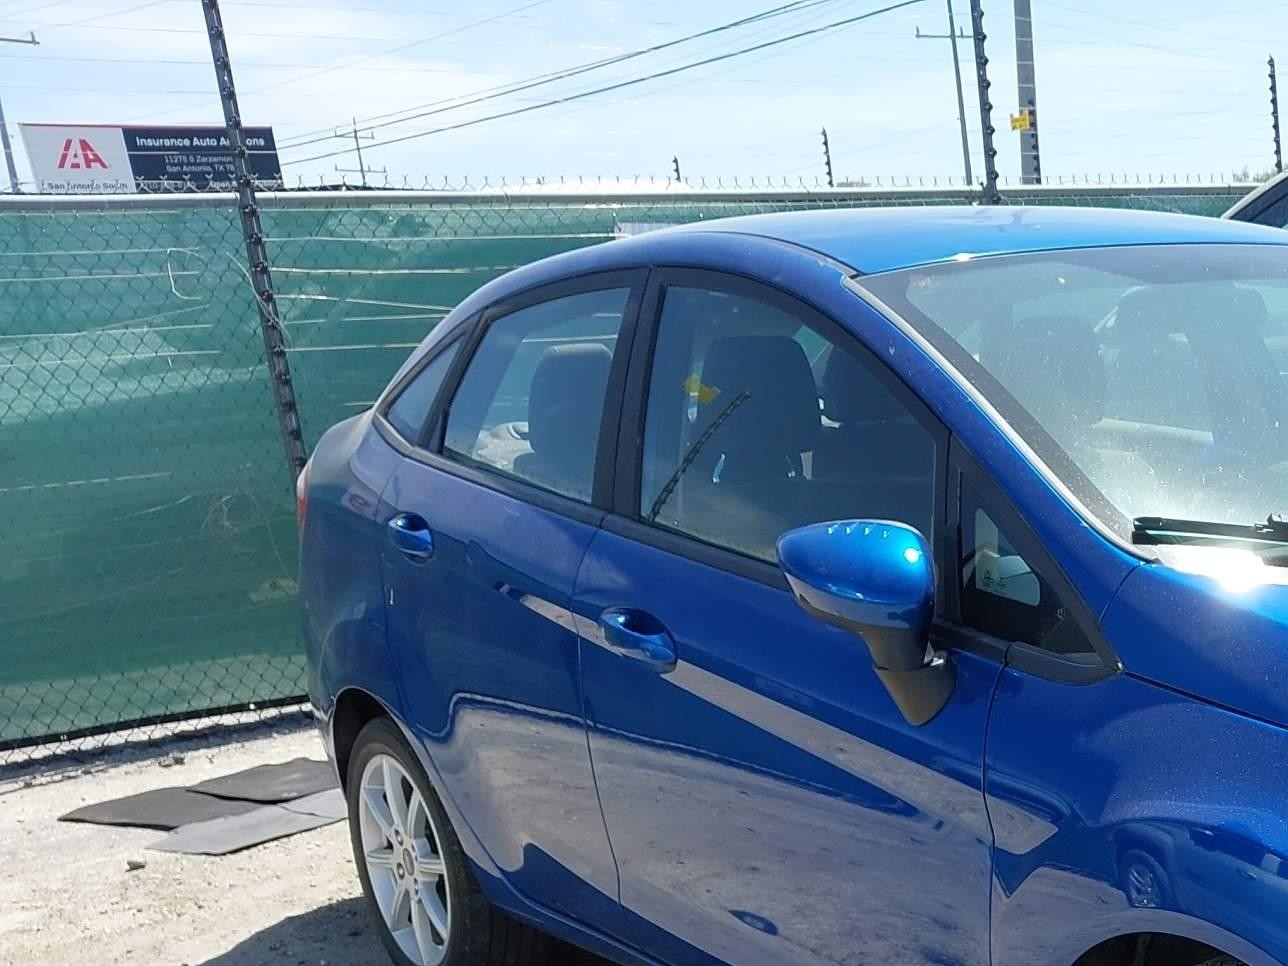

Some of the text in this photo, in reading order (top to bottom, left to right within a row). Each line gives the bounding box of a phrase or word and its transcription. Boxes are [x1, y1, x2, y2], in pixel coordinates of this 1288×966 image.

[136, 136, 265, 147] Insurance Auto Aons
[215, 164, 224, 172] TX
